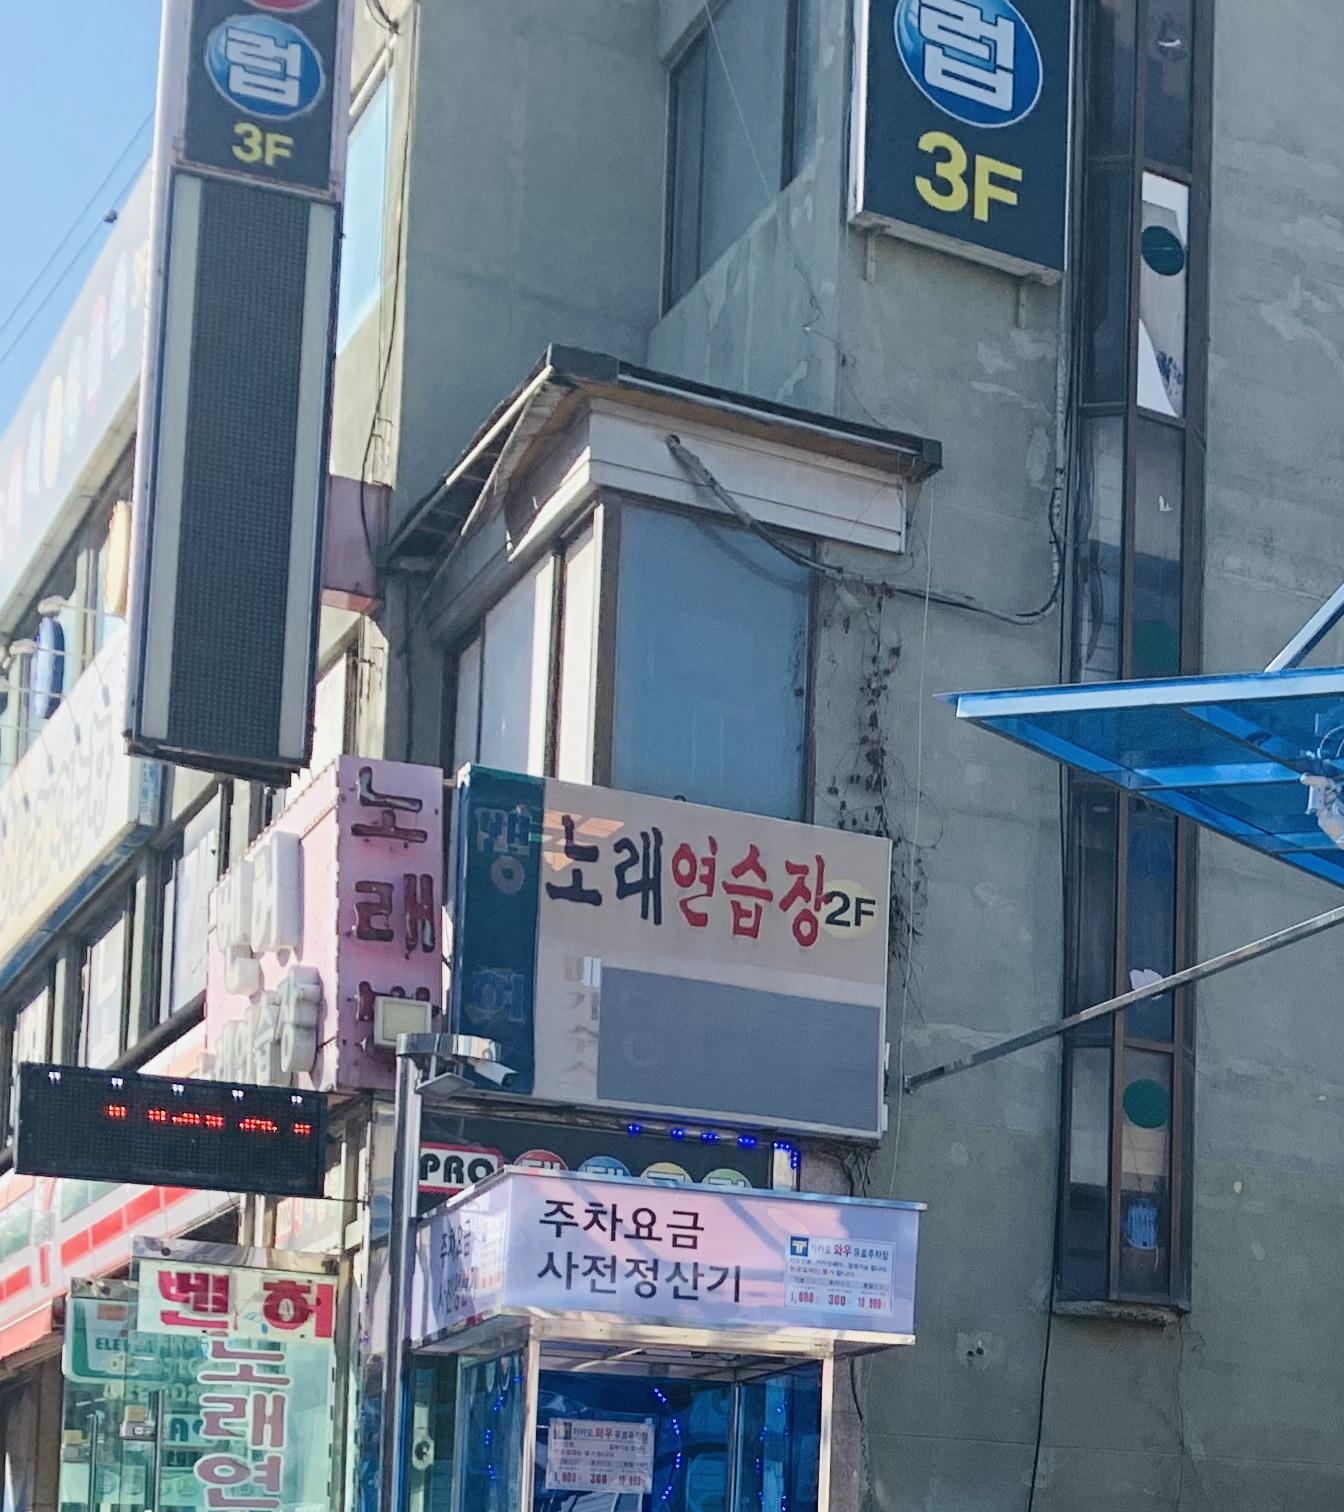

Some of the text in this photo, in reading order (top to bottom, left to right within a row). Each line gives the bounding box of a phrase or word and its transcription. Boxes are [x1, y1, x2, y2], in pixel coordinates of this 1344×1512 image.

[231, 122, 294, 168] 3F
[915, 131, 1022, 222] 3F
[545, 815, 828, 947] 노래연습장
[825, 891, 876, 927] 2F
[419, 1153, 494, 1184] PRO
[538, 1199, 705, 1250] 주차요금
[834, 1244, 852, 1257] 와우
[537, 1251, 741, 1302] 사전정산기
[158, 1270, 334, 1338] 벤허
